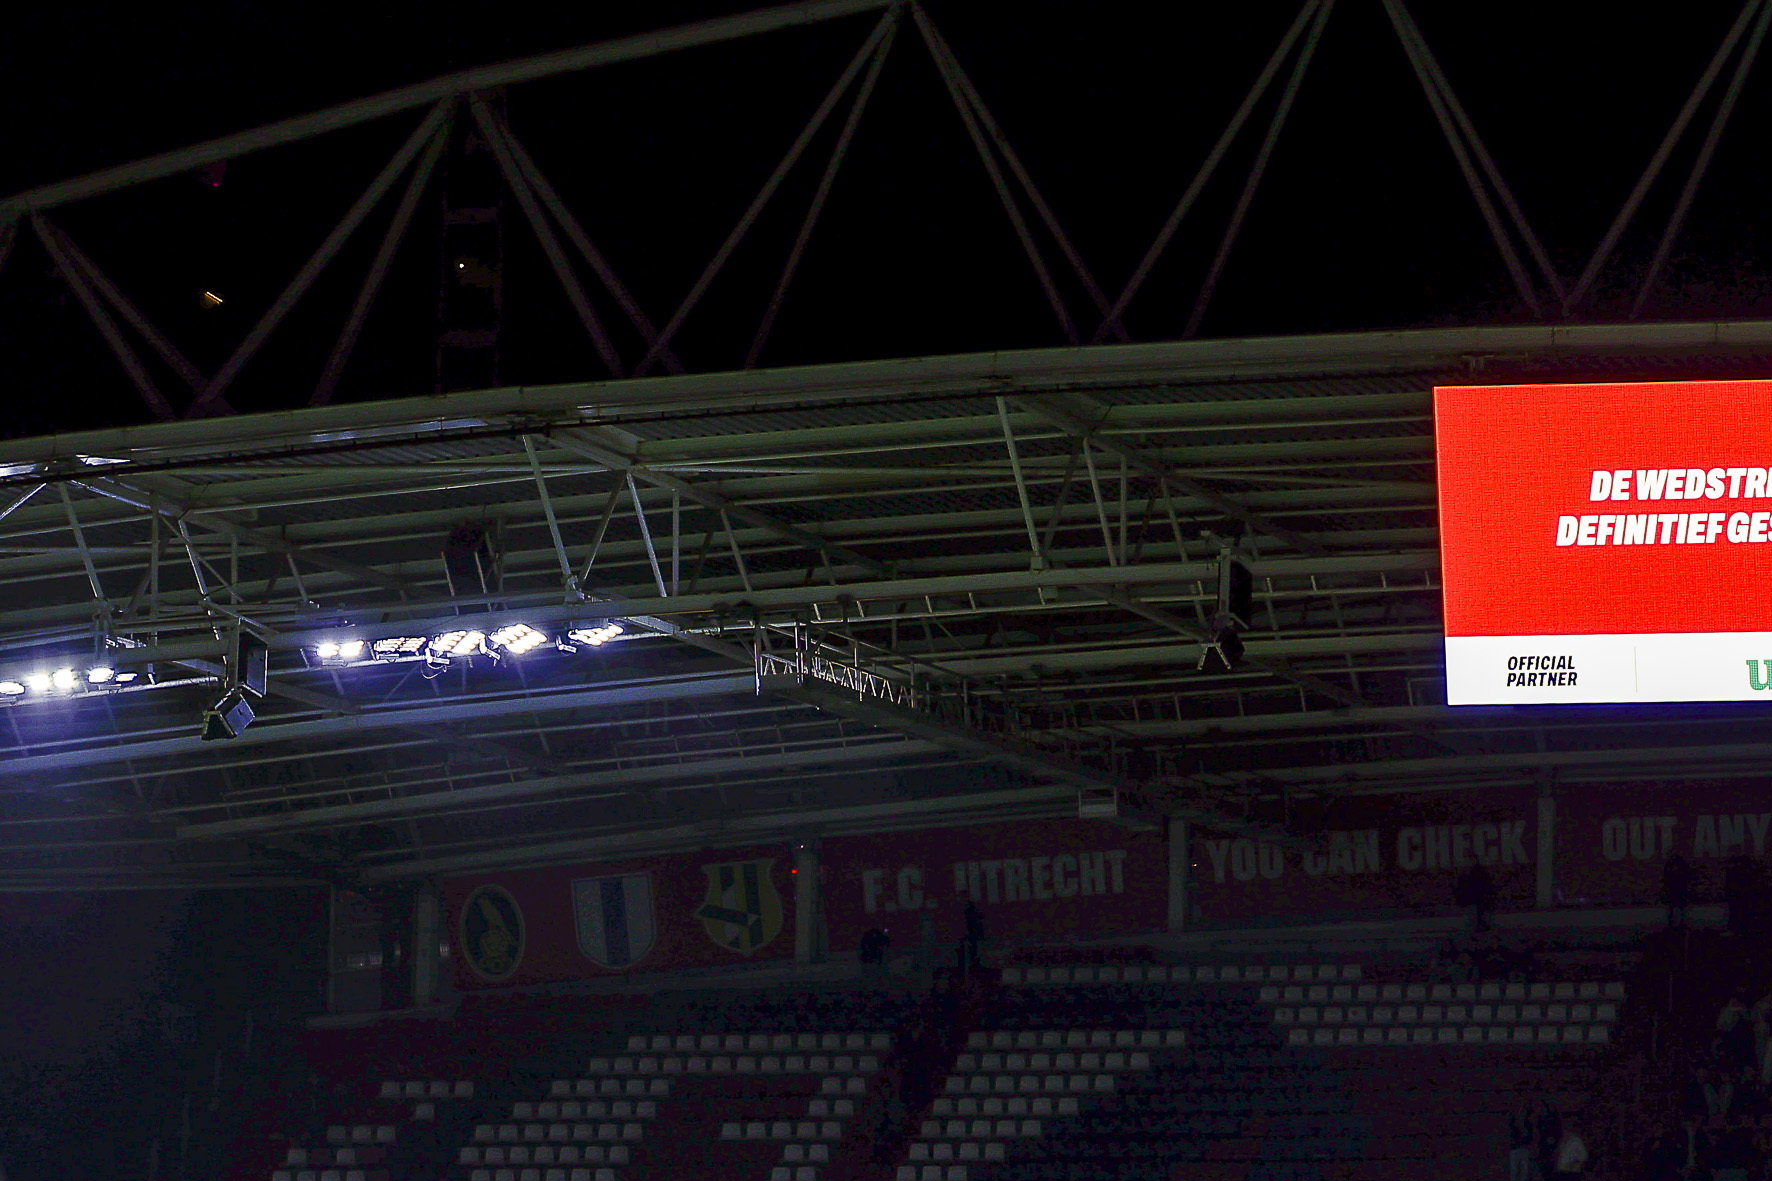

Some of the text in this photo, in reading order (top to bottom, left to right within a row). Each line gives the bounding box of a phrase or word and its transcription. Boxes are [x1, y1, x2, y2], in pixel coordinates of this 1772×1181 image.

[1590, 469, 1632, 501] DE
[1556, 511, 1724, 546] DEFINITIEF
[1506, 671, 1578, 687] PARTNER
[1507, 655, 1576, 670] OFFICIAL
[1205, 819, 1531, 884] YOU CAN CHECK
[1600, 816, 1679, 863] OUT
[862, 849, 1128, 914] F.C. UTRECHT
